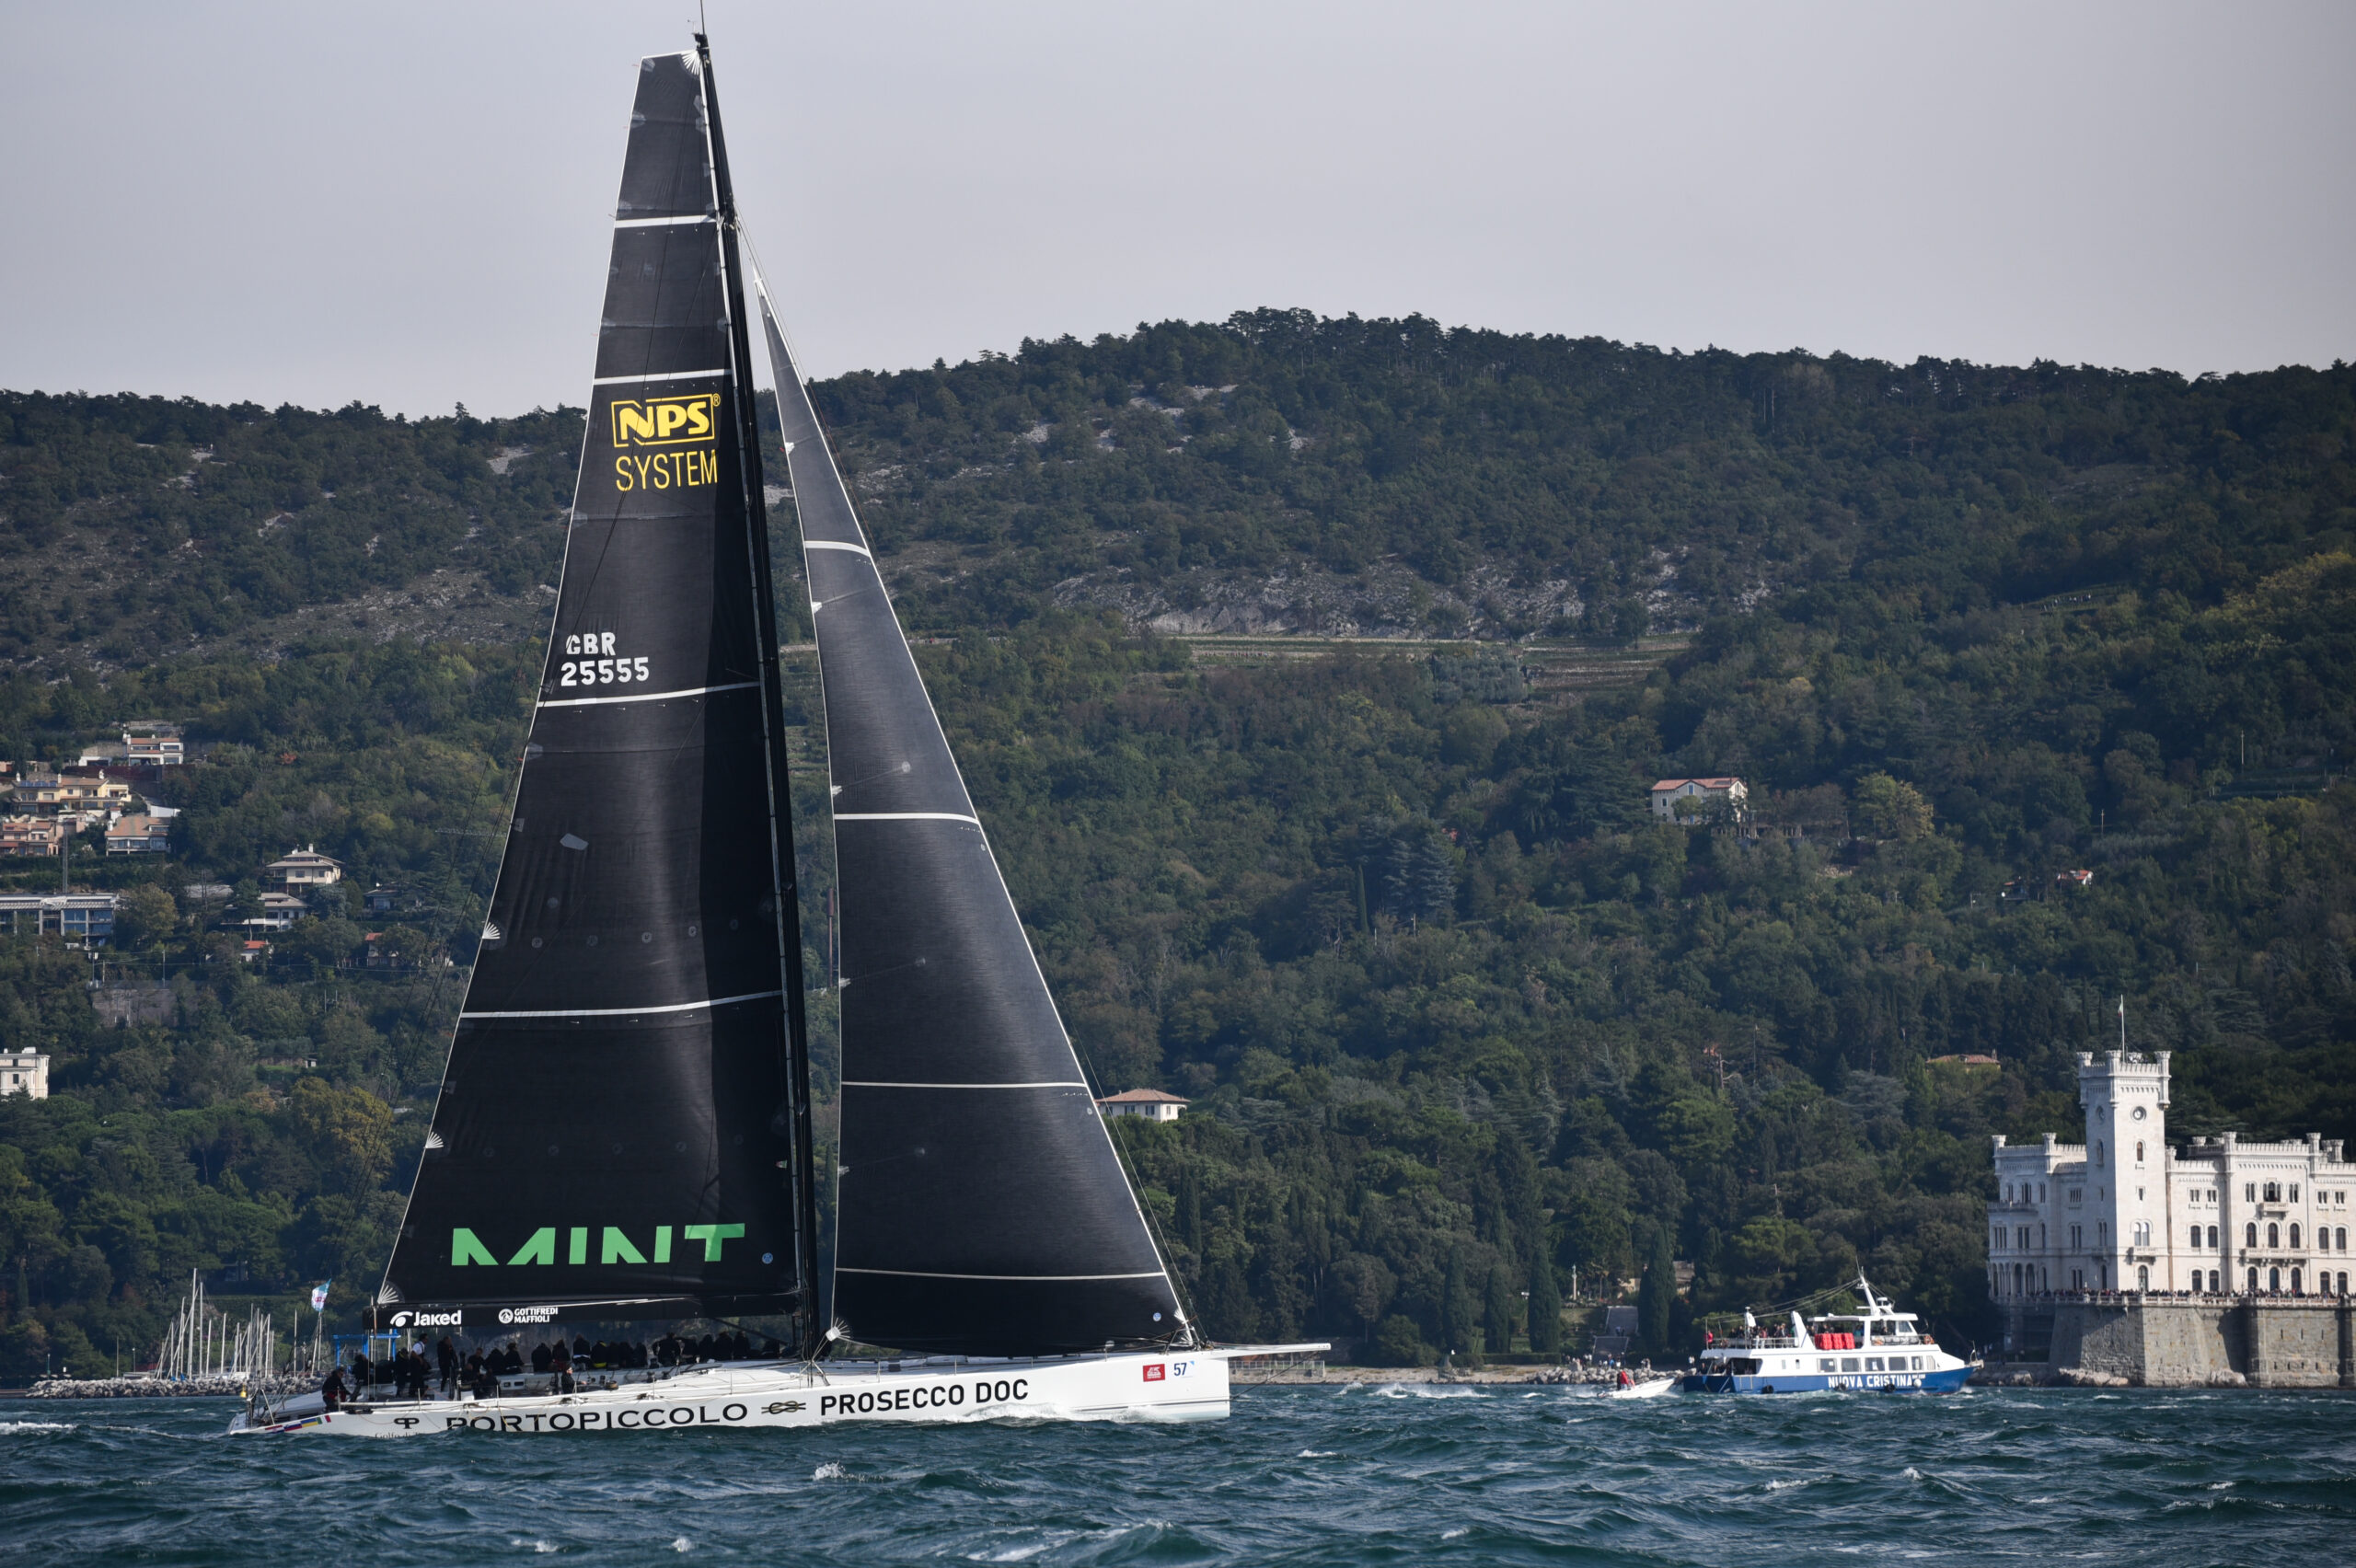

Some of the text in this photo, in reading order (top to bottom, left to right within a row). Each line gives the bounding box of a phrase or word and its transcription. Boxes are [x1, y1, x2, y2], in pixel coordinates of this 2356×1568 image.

[619, 401, 710, 440] NPS
[616, 449, 718, 491] SYSTEM
[566, 632, 616, 656] GBR
[560, 657, 650, 686] 25555
[451, 1223, 745, 1266] MINT
[413, 1309, 462, 1327] Jaked
[514, 1308, 559, 1316] GOTTIFREDI
[514, 1315, 550, 1323] MAFFIOLI
[1173, 1362, 1187, 1377] 57
[1828, 1376, 1863, 1389] NUOVA
[1866, 1374, 1913, 1388] CRISTINA
[821, 1378, 1029, 1416] PROSECCO DOC
[445, 1403, 748, 1433] PORTOPICCOLO
